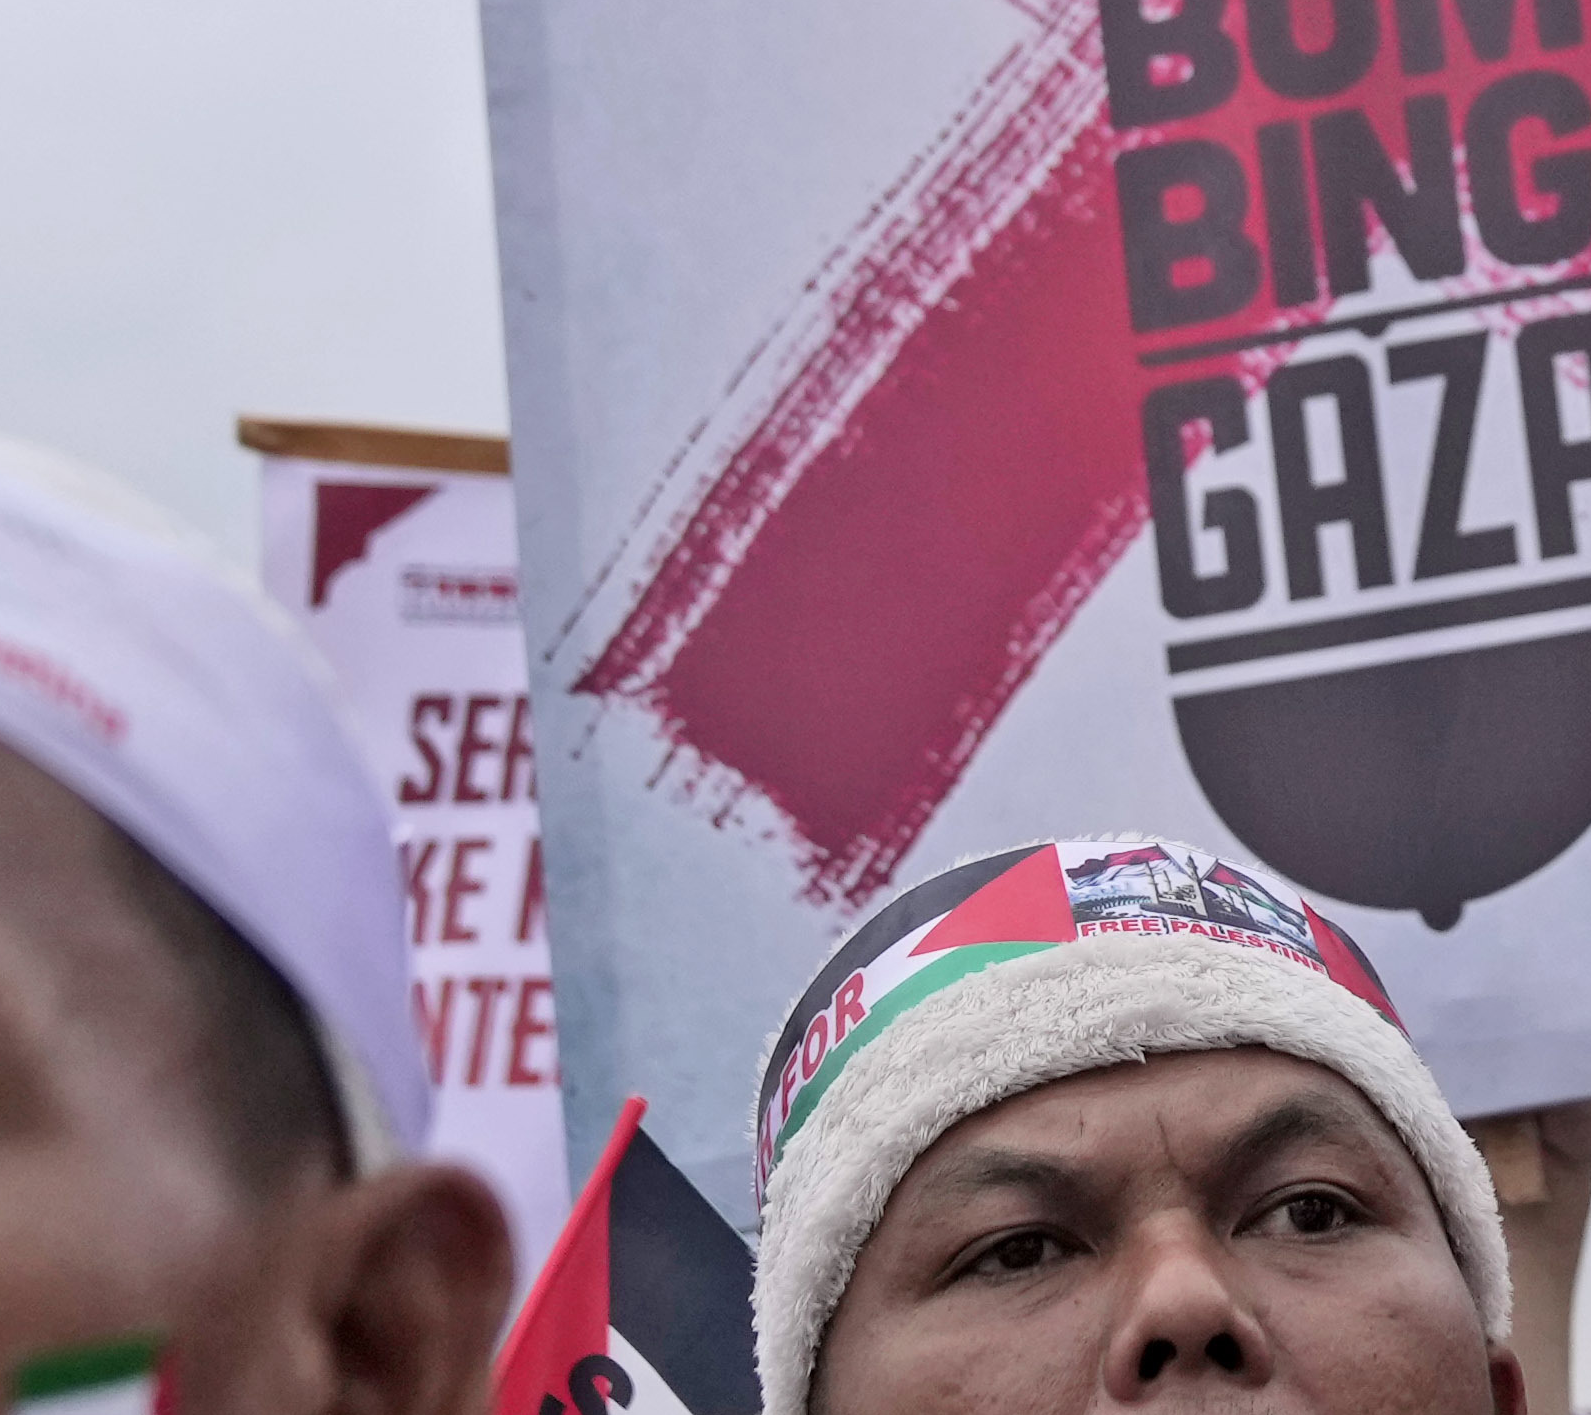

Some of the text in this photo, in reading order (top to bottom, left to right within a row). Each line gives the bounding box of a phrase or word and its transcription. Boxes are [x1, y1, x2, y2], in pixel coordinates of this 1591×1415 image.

[1080, 918, 1327, 976] FREE PALESTINE
[780, 972, 866, 1124] FOR
